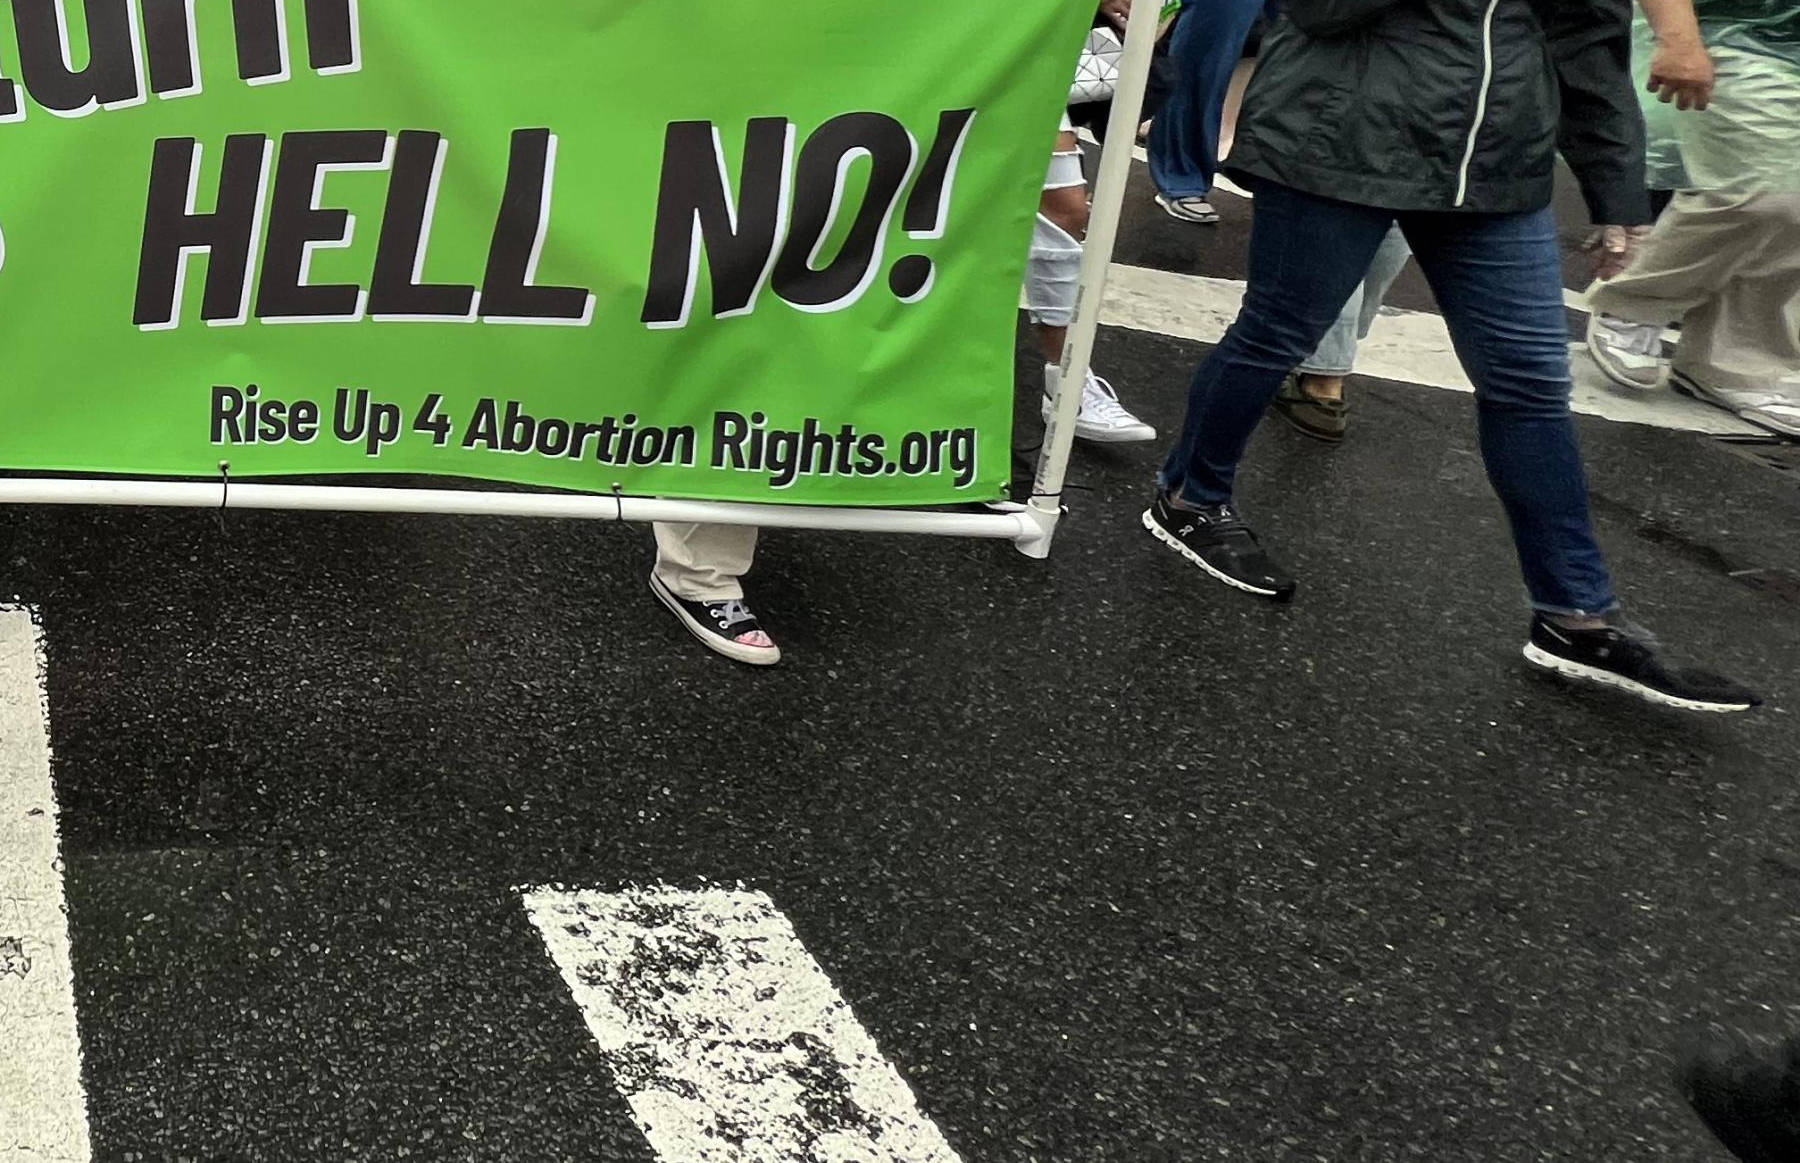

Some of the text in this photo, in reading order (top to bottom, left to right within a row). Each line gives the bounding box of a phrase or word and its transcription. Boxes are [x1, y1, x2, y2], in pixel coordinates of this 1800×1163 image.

[131, 106, 979, 331] HELL NO!
[208, 384, 979, 490] Rise Up 4 Abortion Rights.org
